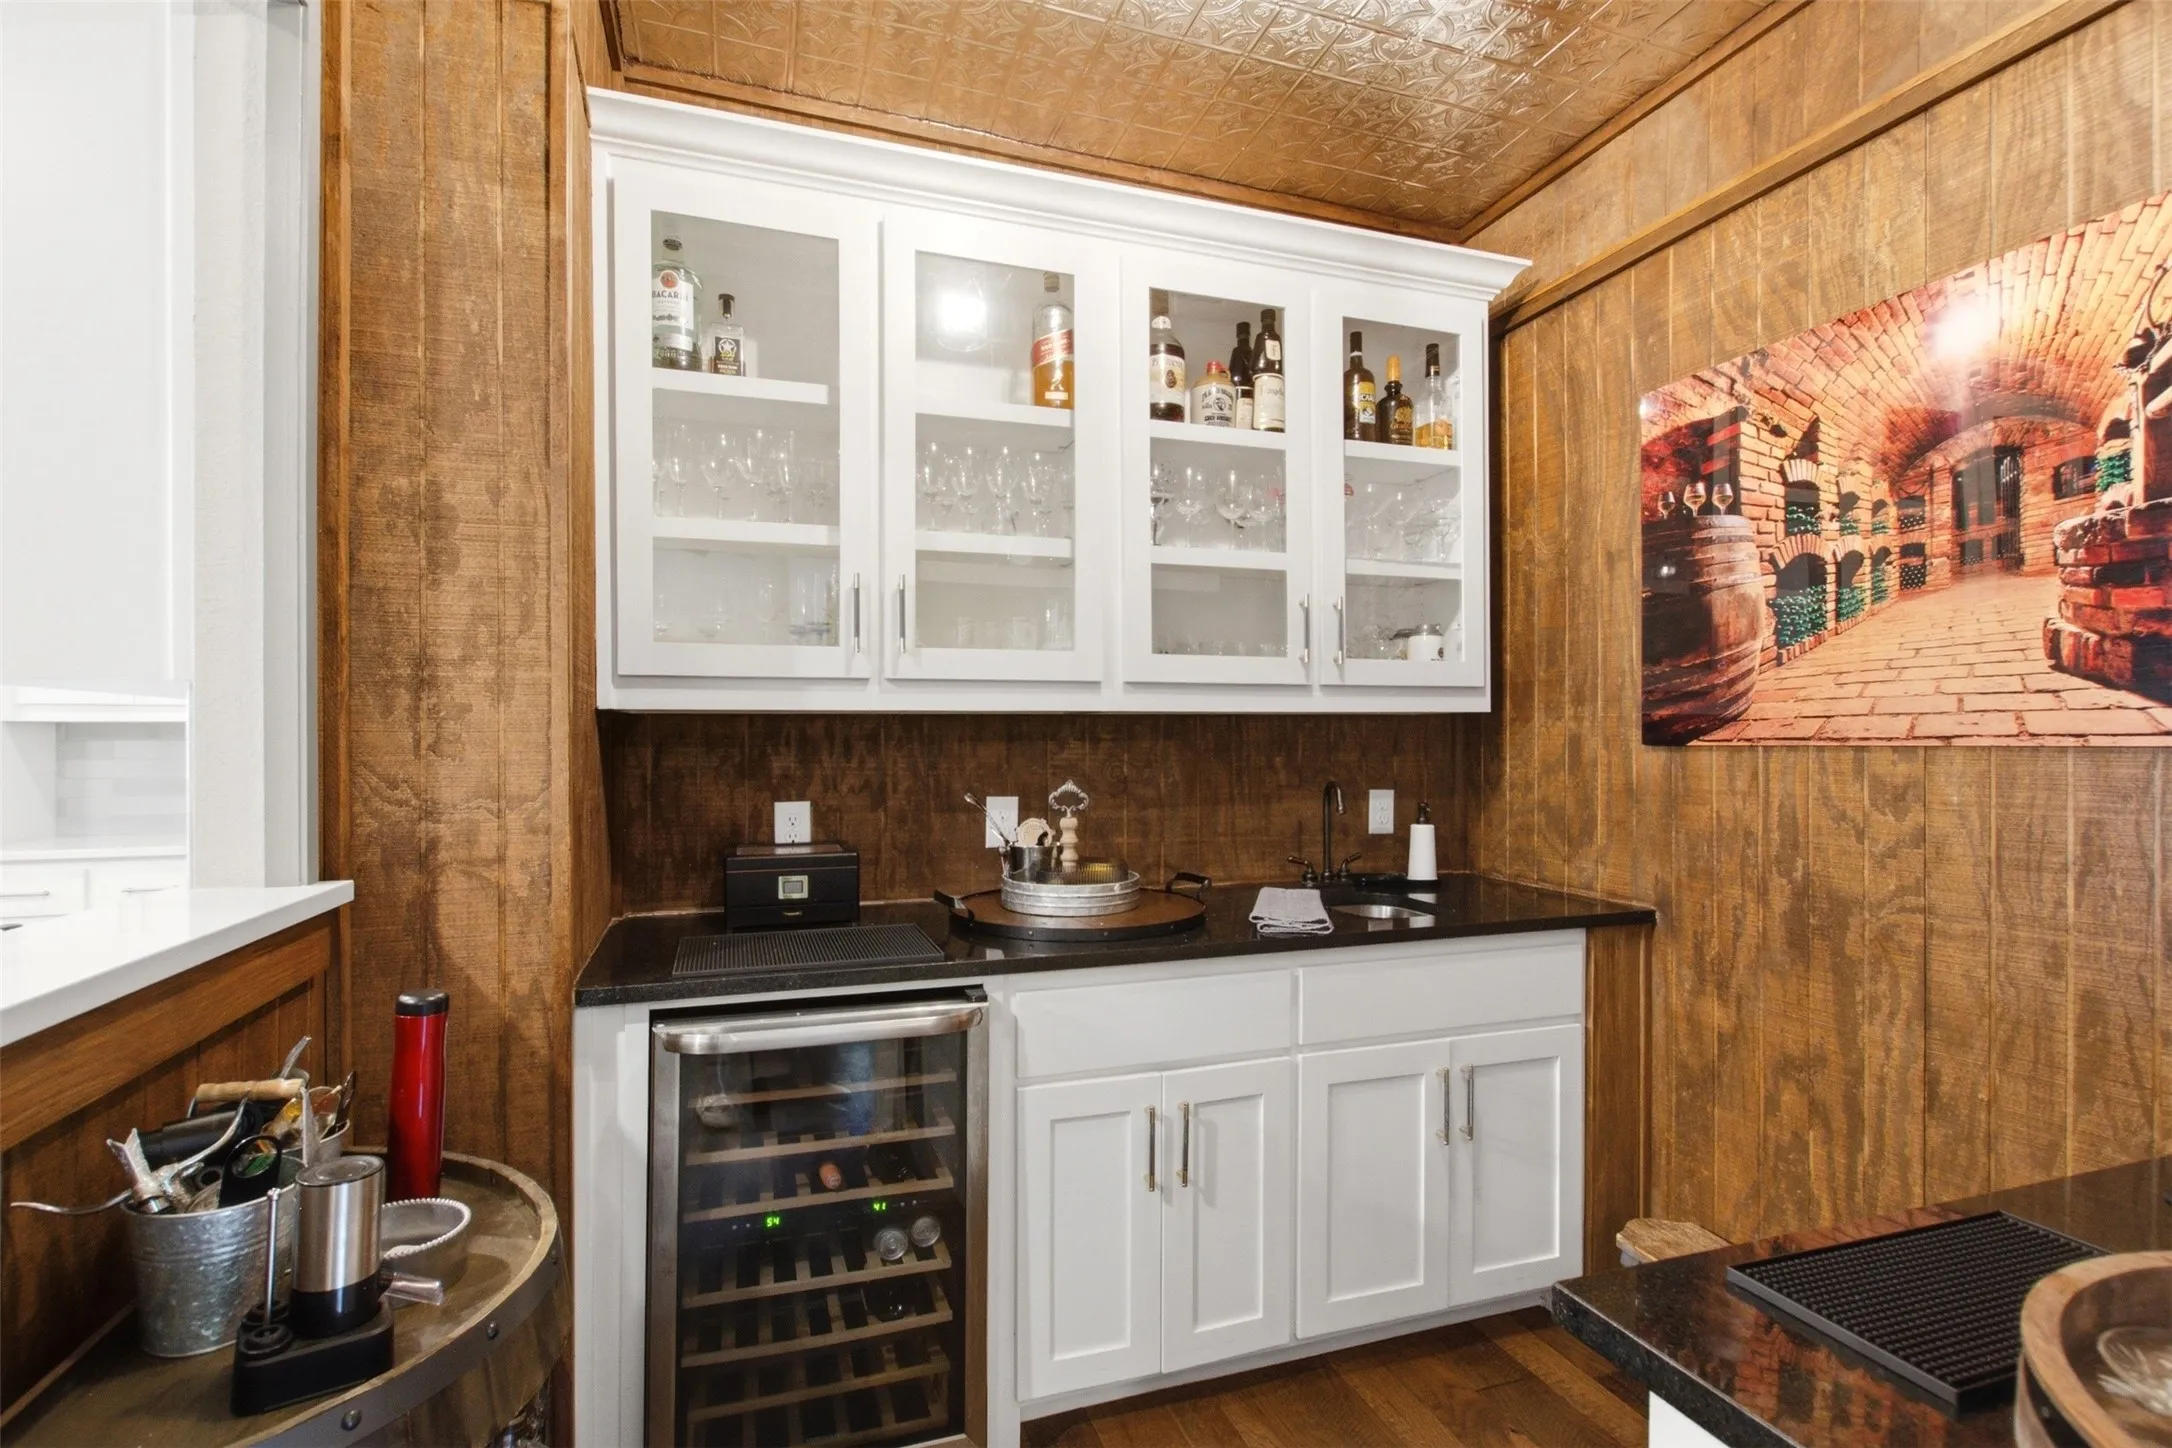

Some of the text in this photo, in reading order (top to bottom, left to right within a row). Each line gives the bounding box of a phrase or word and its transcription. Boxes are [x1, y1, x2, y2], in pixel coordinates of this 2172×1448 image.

[652, 290, 688, 301] BACARI
[873, 1202, 886, 1211] 41
[766, 1216, 780, 1227] 54
